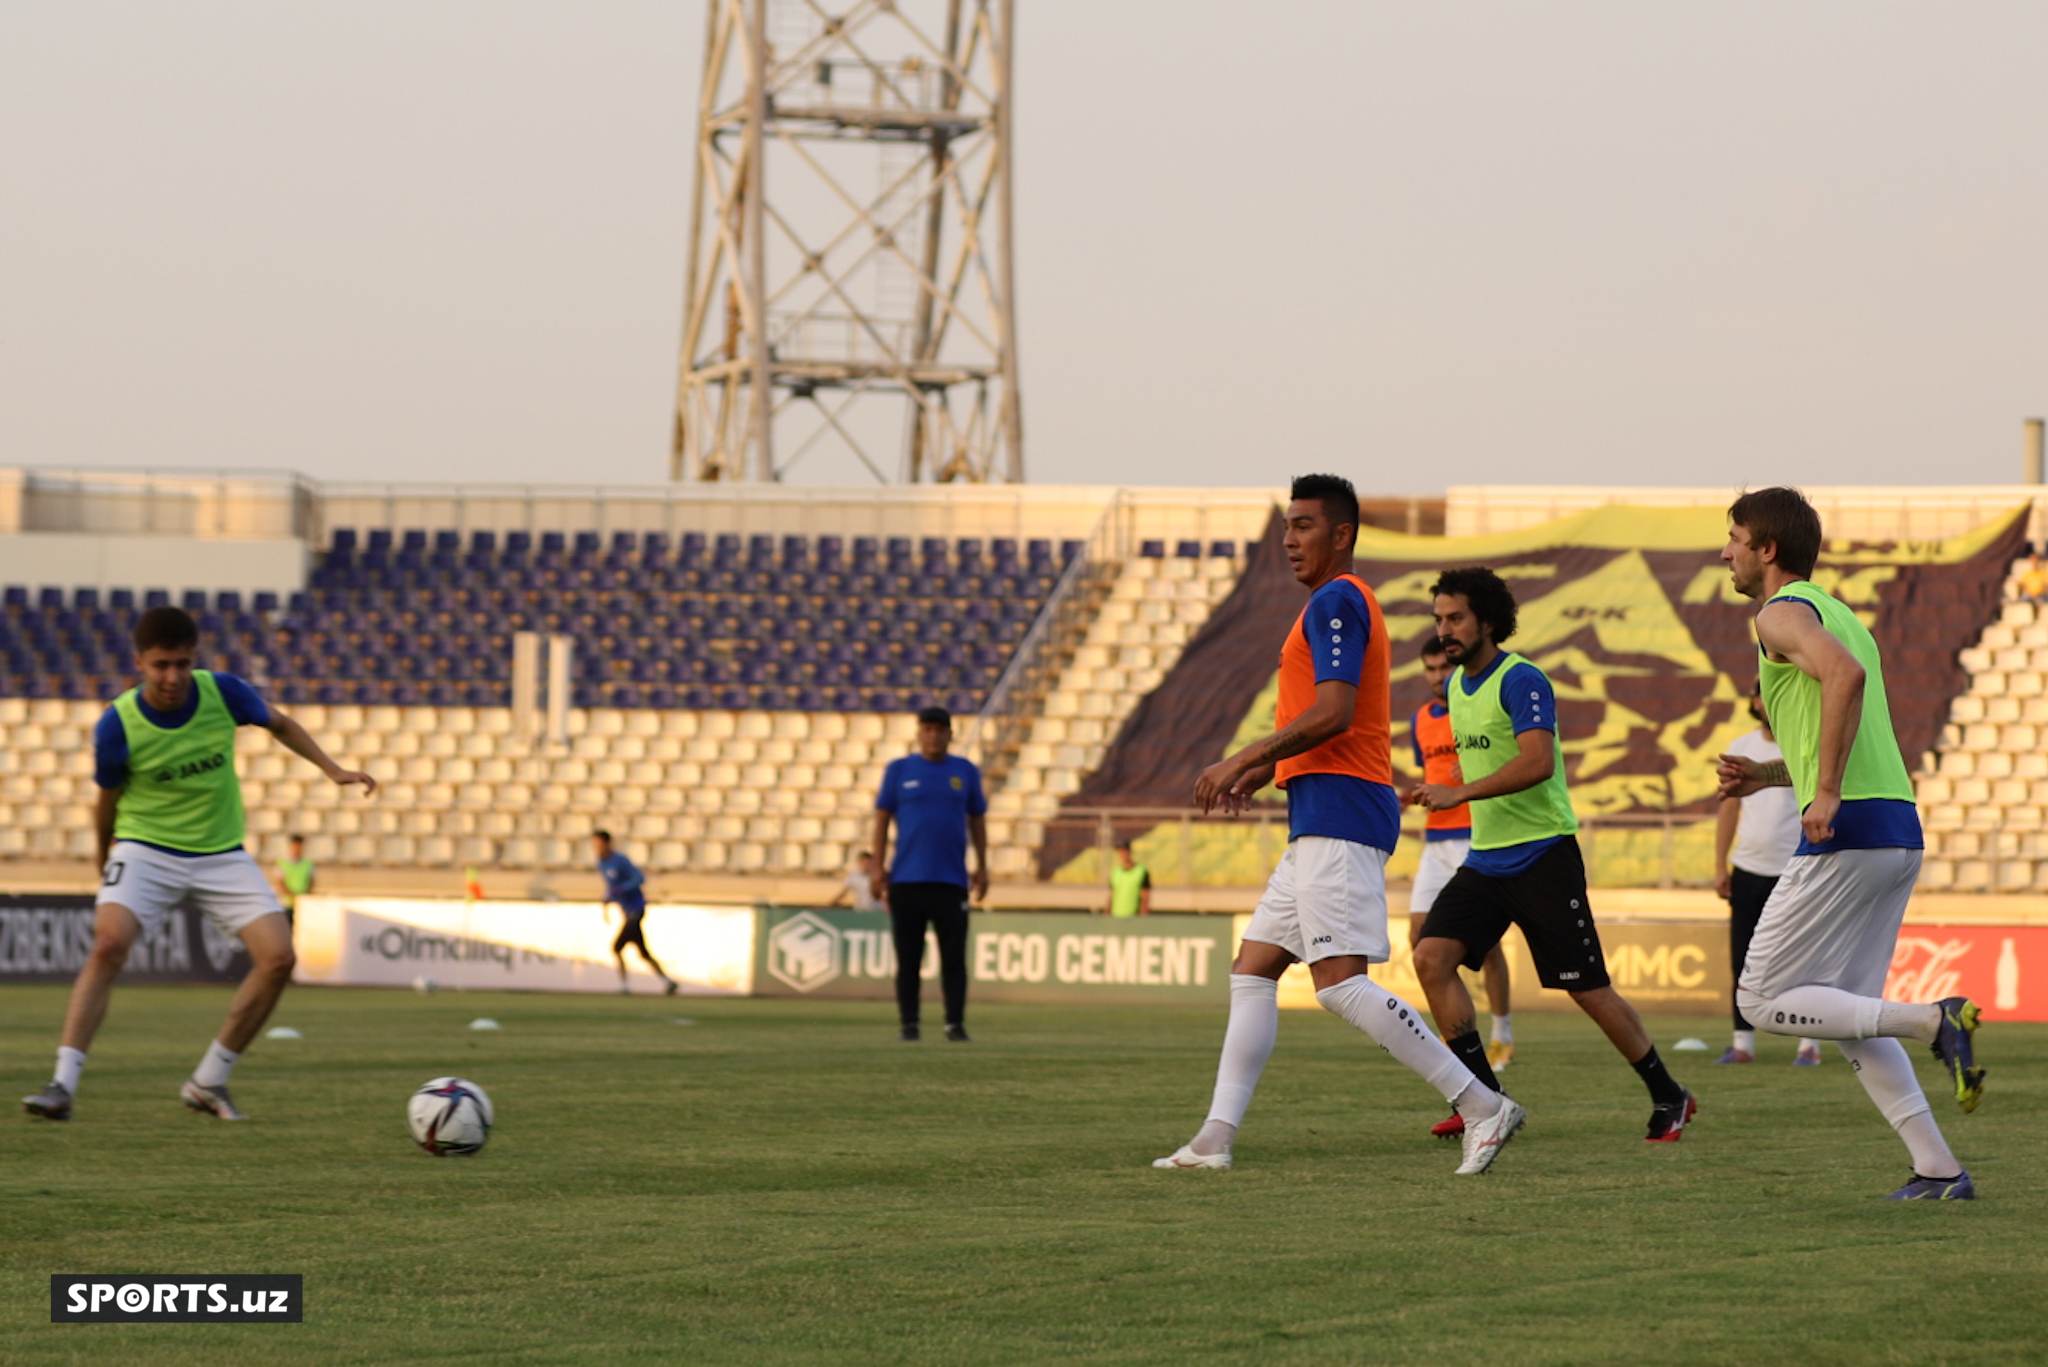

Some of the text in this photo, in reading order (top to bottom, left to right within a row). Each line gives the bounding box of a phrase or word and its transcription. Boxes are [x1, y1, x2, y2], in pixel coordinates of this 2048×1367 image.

[180, 753, 225, 779] JAKO
[974, 932, 1048, 982] ECO
[1055, 935, 1215, 986] CEMENT
